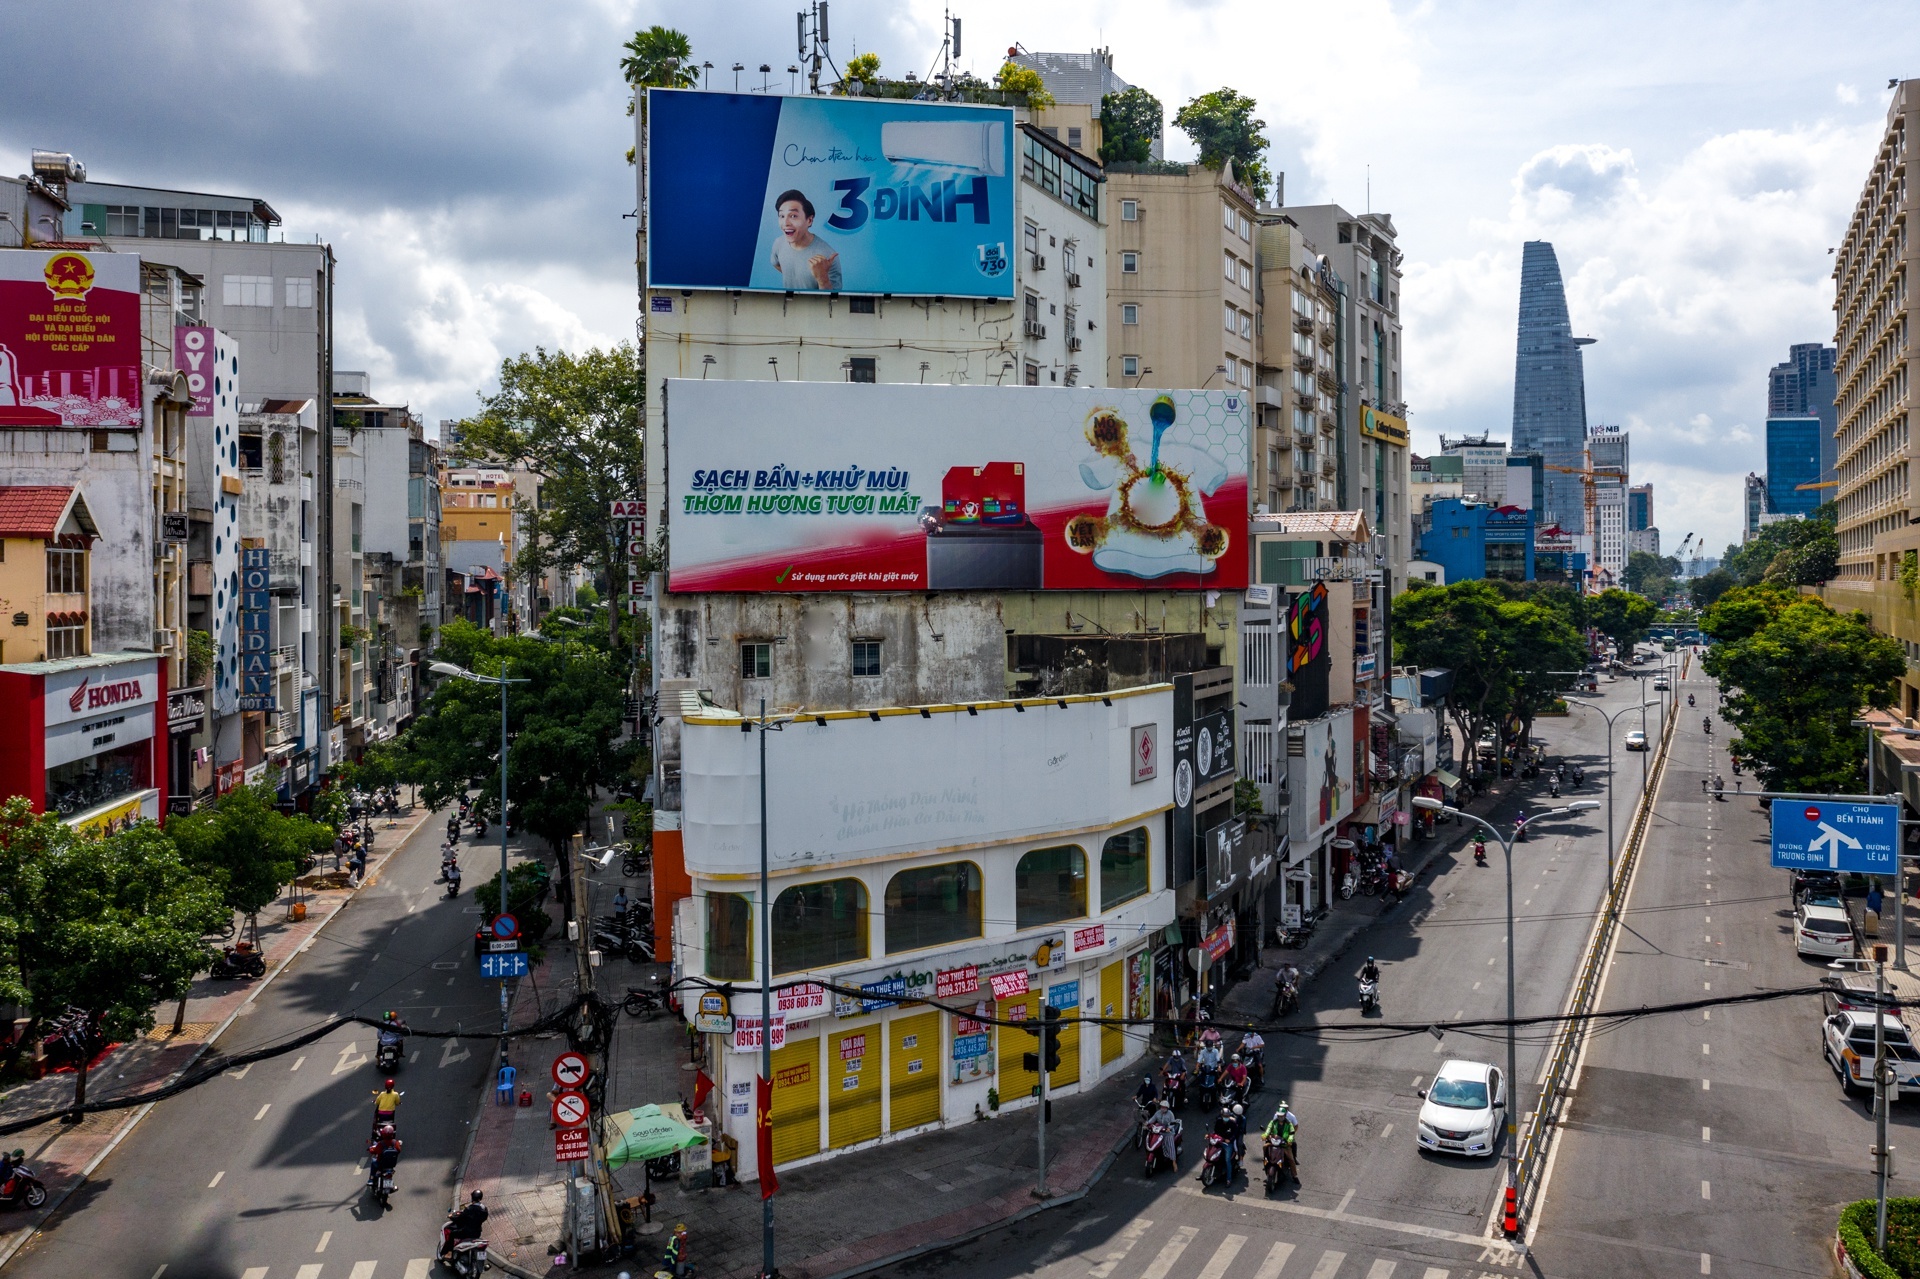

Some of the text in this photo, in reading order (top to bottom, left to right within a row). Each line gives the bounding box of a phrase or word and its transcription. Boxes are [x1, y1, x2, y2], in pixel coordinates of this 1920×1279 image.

[784, 144, 877, 167] Chọn điều hòa
[828, 177, 990, 230] 3 ĐỈNH
[981, 259, 1006, 271] 730
[29, 314, 44, 323] ĐẠI
[70, 313, 93, 323] QUỐC
[95, 314, 111, 324] HỘI
[44, 323, 56, 332] VÀ
[58, 324, 73, 333] ĐẠI
[25, 333, 40, 342] HỘI
[70, 333, 94, 342] NHÂN
[97, 333, 115, 342] DÂN
[51, 343, 69, 351] CÁC
[185, 331, 206, 392] OYO
[1605, 425, 1620, 433] MB
[693, 469, 750, 493] SẠCH
[867, 466, 909, 488] MÙI
[684, 491, 921, 512] THƠM HƯƠNG TƯƠI MÁT
[613, 502, 647, 516] A25
[165, 516, 181, 526] Flat
[165, 526, 185, 536] White
[791, 572, 919, 583] Sử dụng nước giặt khi giặt máy
[247, 550, 264, 692] HOLIDAY
[88, 680, 142, 709] HONDA
[171, 803, 186, 812] Flat
[1852, 806, 1869, 814] CHỢ
[1836, 812, 1884, 825] BẾN THÀNH
[1778, 842, 1803, 850] ĐƯỜNG
[1865, 842, 1891, 851] ĐƯỜNG
[1807, 853, 1824, 863] ĐỊNH
[1867, 851, 1889, 861] LÊ LAI
[1008, 953, 1027, 963] Chain
[937, 967, 977, 984] CHO THUÊ NHÀ
[990, 976, 1003, 986] CHO
[1003, 973, 1017, 983] THUÊ
[793, 986, 806, 996] CHO
[876, 980, 905, 993] THUÊ NHÀ
[938, 979, 978, 997] 0909.379.251
[778, 995, 823, 1011] 0938 608 739
[736, 1030, 754, 1046] 0916
[771, 1029, 784, 1045] 999
[965, 1037, 977, 1045] THUÊ
[562, 1130, 582, 1141] CẤM
